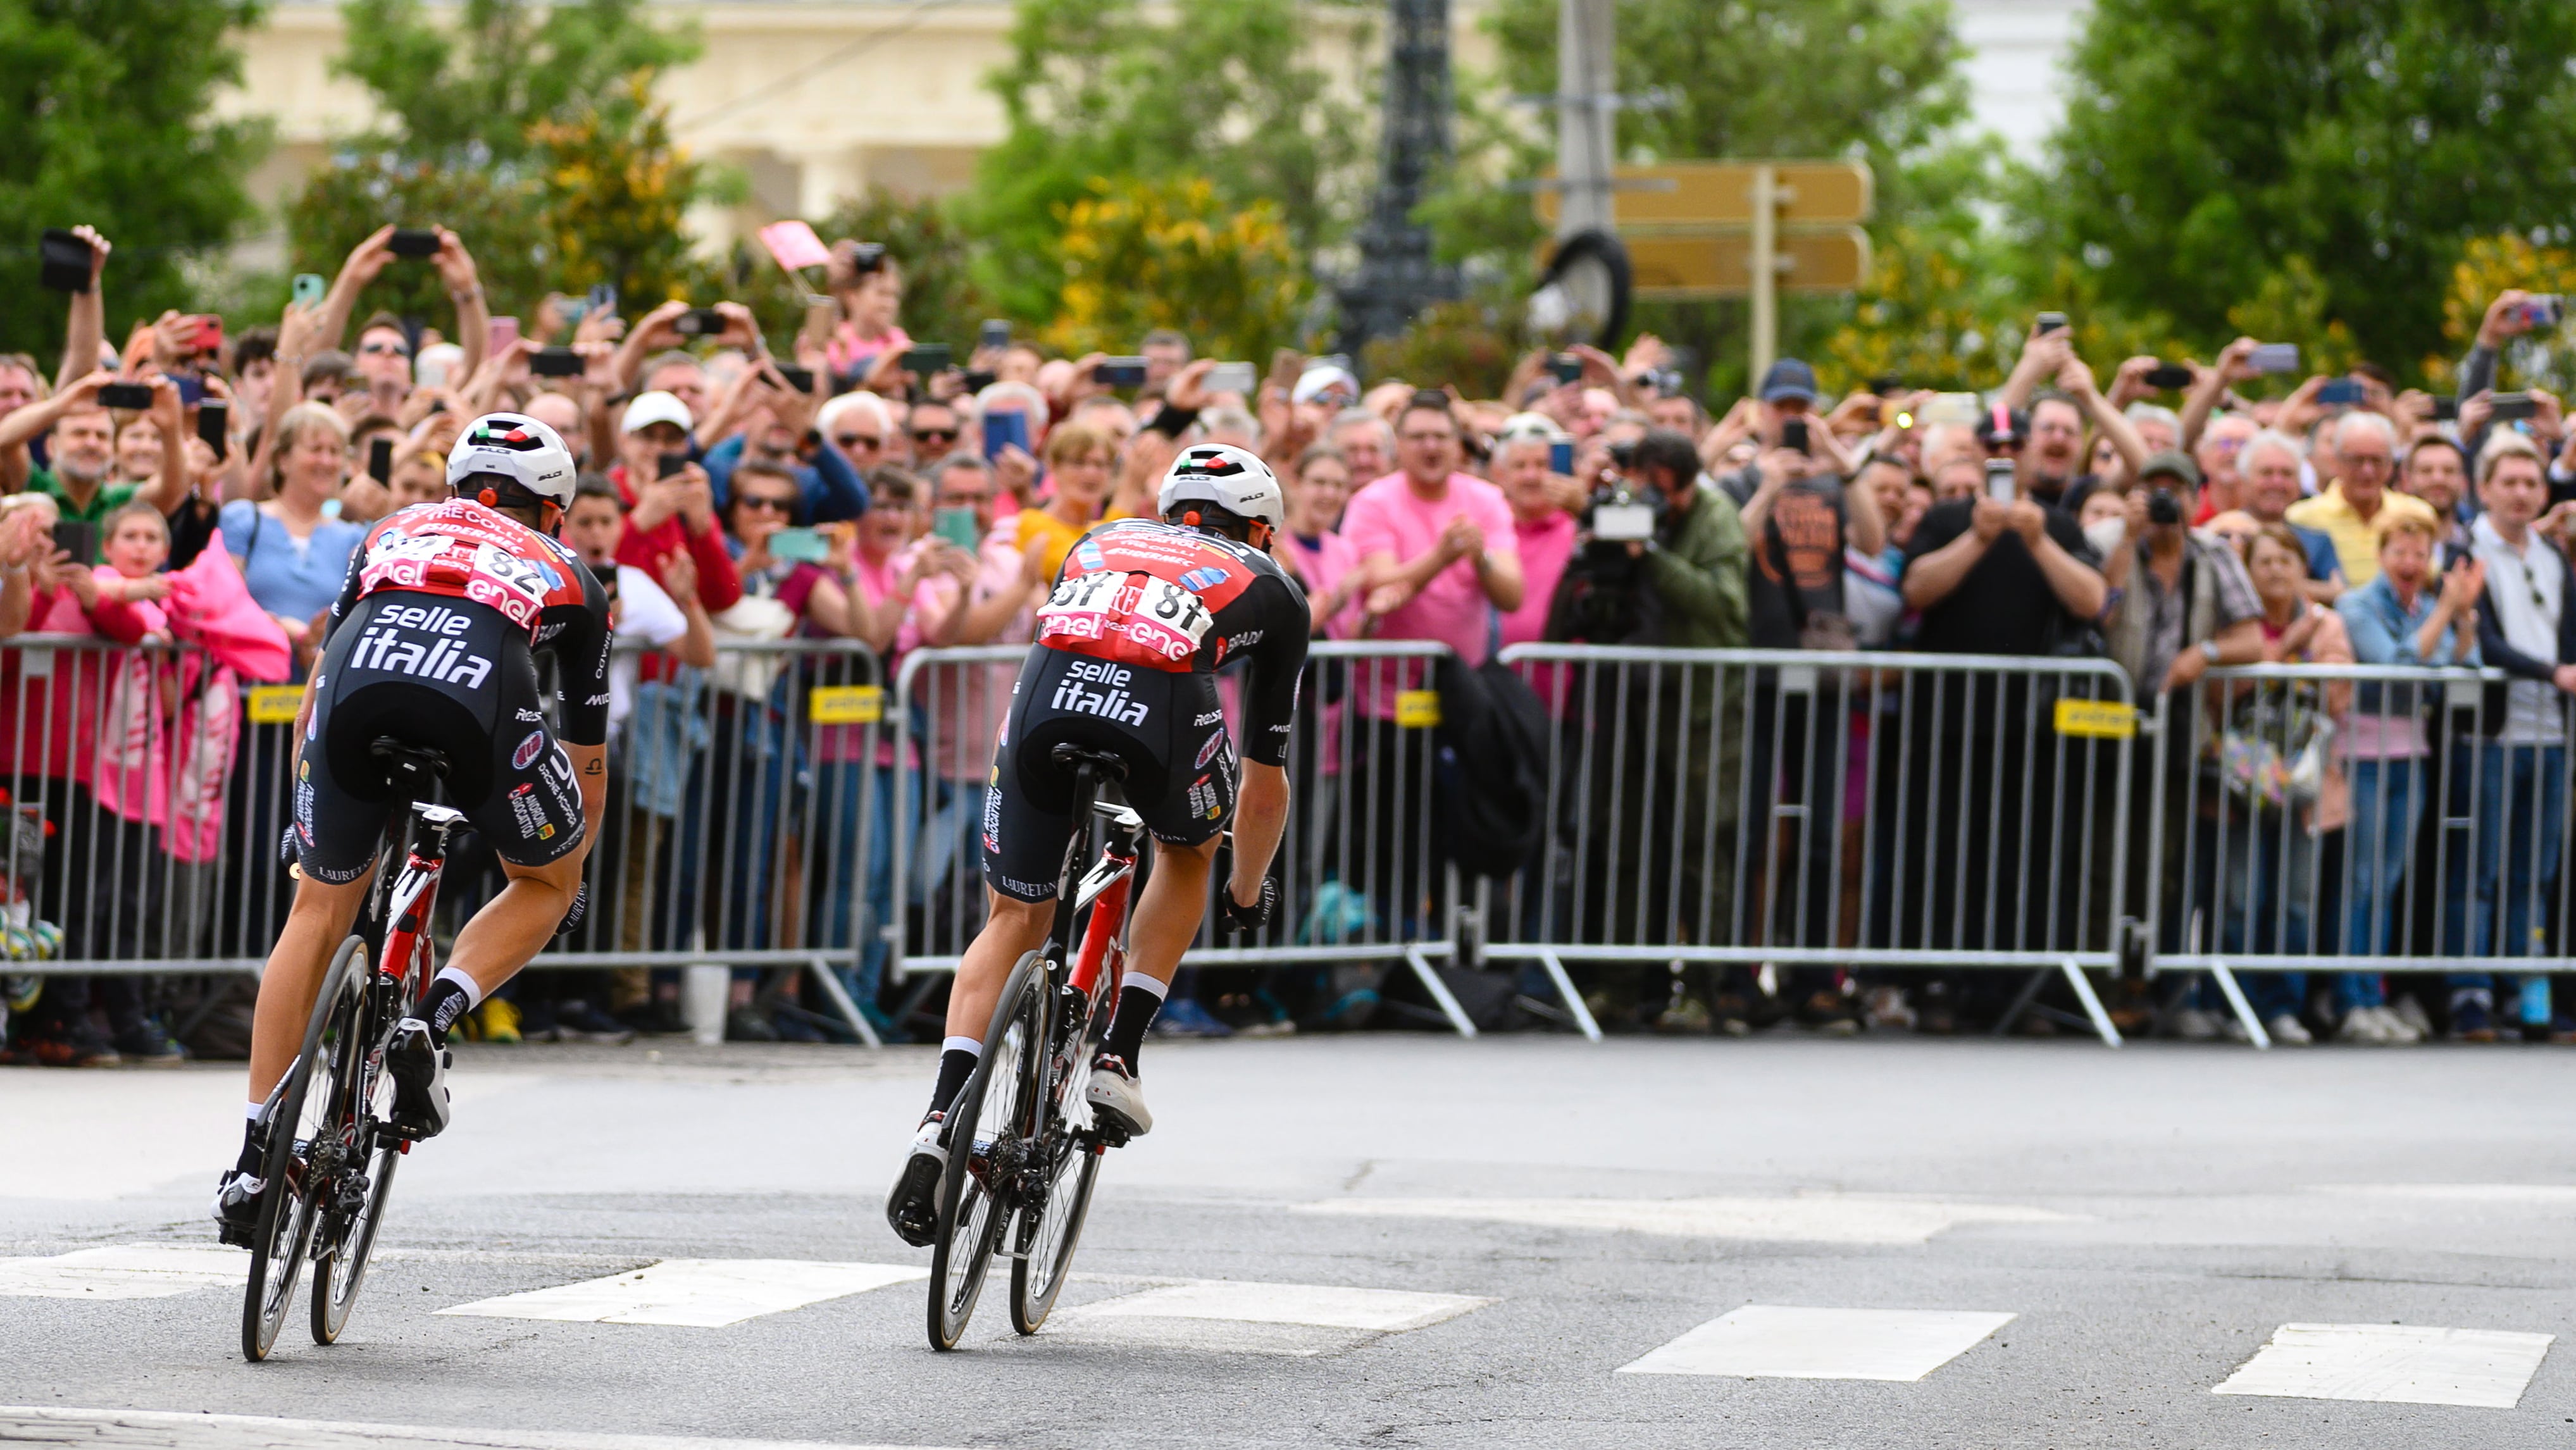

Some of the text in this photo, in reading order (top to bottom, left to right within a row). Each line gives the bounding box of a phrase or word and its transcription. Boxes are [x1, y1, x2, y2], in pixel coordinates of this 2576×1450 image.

[491, 552, 542, 595] 82
[373, 605, 471, 636] selle
[466, 579, 538, 627] enel
[351, 628, 493, 690] italia
[1066, 660, 1131, 687] selle
[1051, 679, 1149, 727] italia
